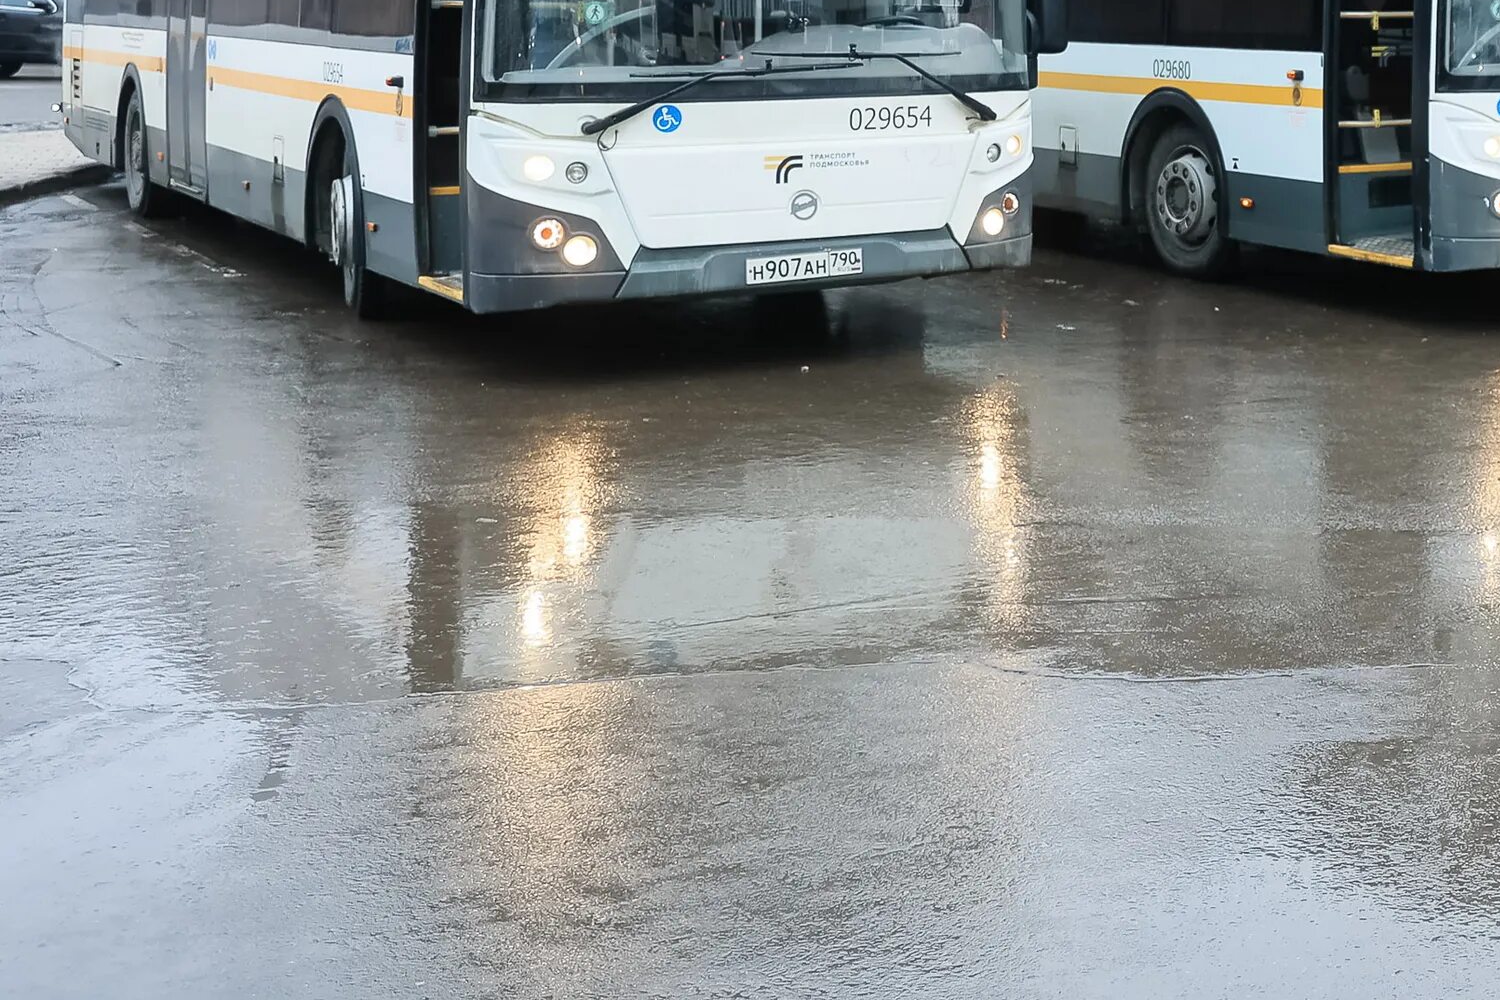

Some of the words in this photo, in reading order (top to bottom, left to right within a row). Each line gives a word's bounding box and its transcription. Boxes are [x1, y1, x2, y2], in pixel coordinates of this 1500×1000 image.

[1153, 59, 1191, 79] 029680
[849, 105, 932, 131] 029654
[809, 152, 856, 160] ТРАНСПОРТ
[809, 160, 870, 169] ПОДМОСКОВЬЯ
